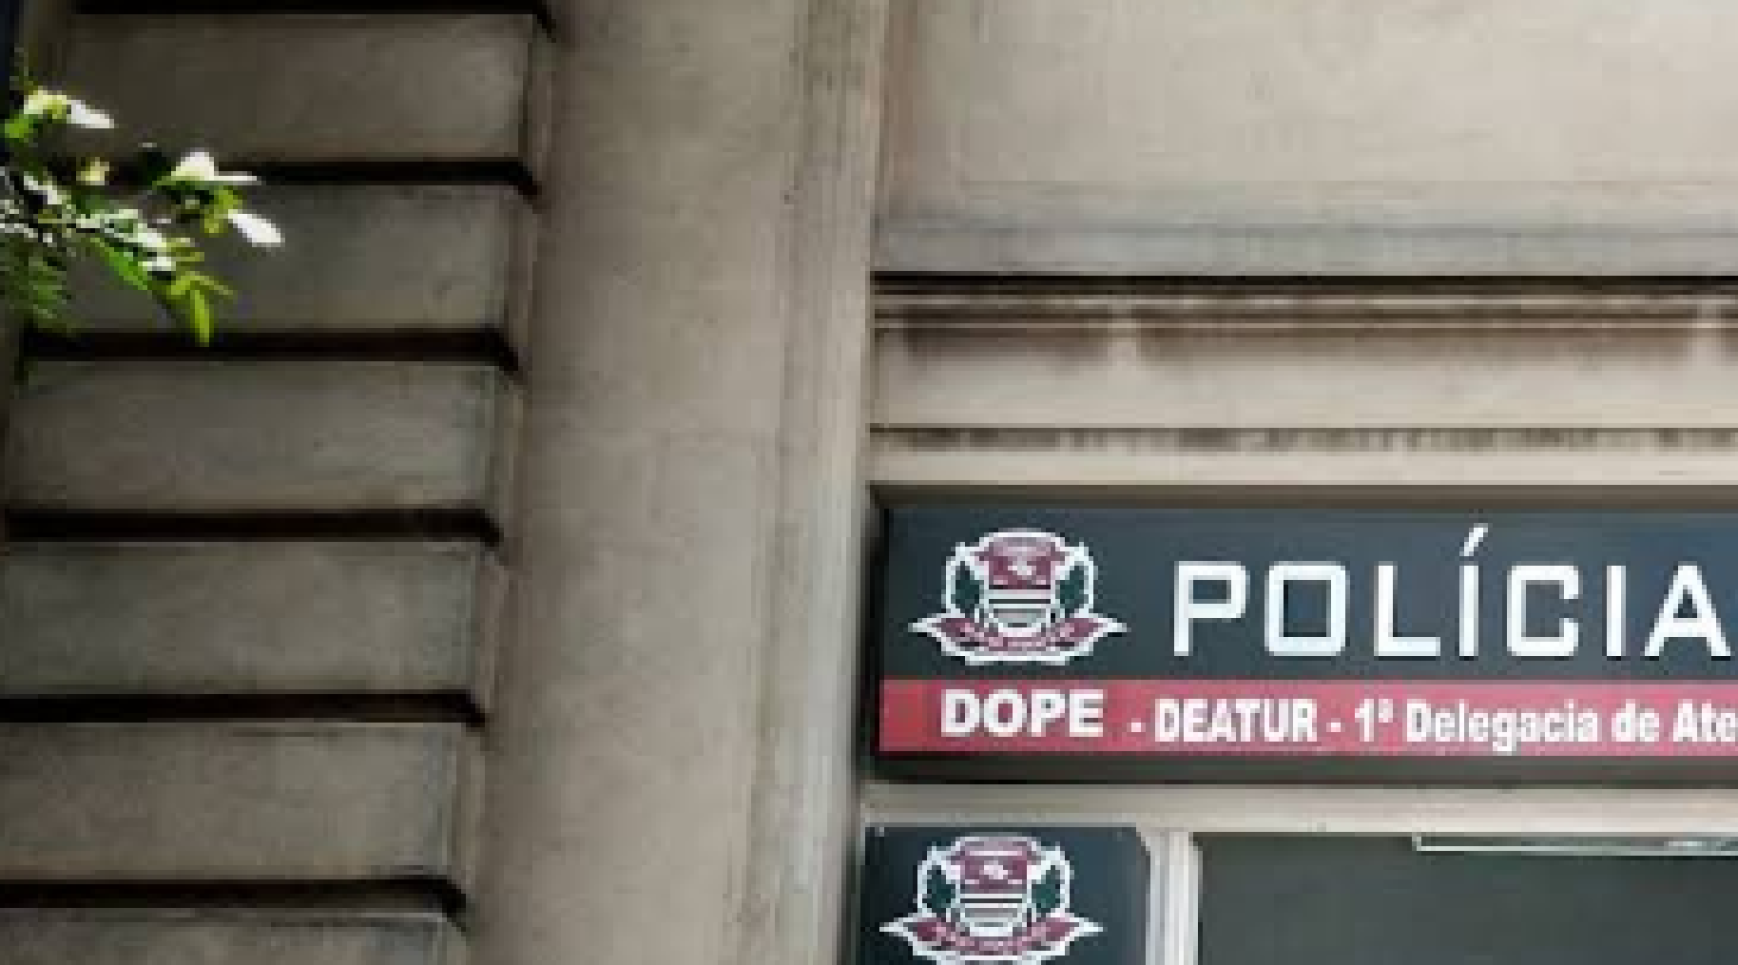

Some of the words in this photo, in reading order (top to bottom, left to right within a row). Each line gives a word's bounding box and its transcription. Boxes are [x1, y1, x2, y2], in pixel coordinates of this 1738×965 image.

[1172, 523, 1732, 660] POLÍCIA
[940, 687, 1104, 738] DOPE
[1154, 697, 1318, 743] DEATUR
[1406, 698, 1599, 752] Delegacia
[1611, 698, 1660, 743] de
